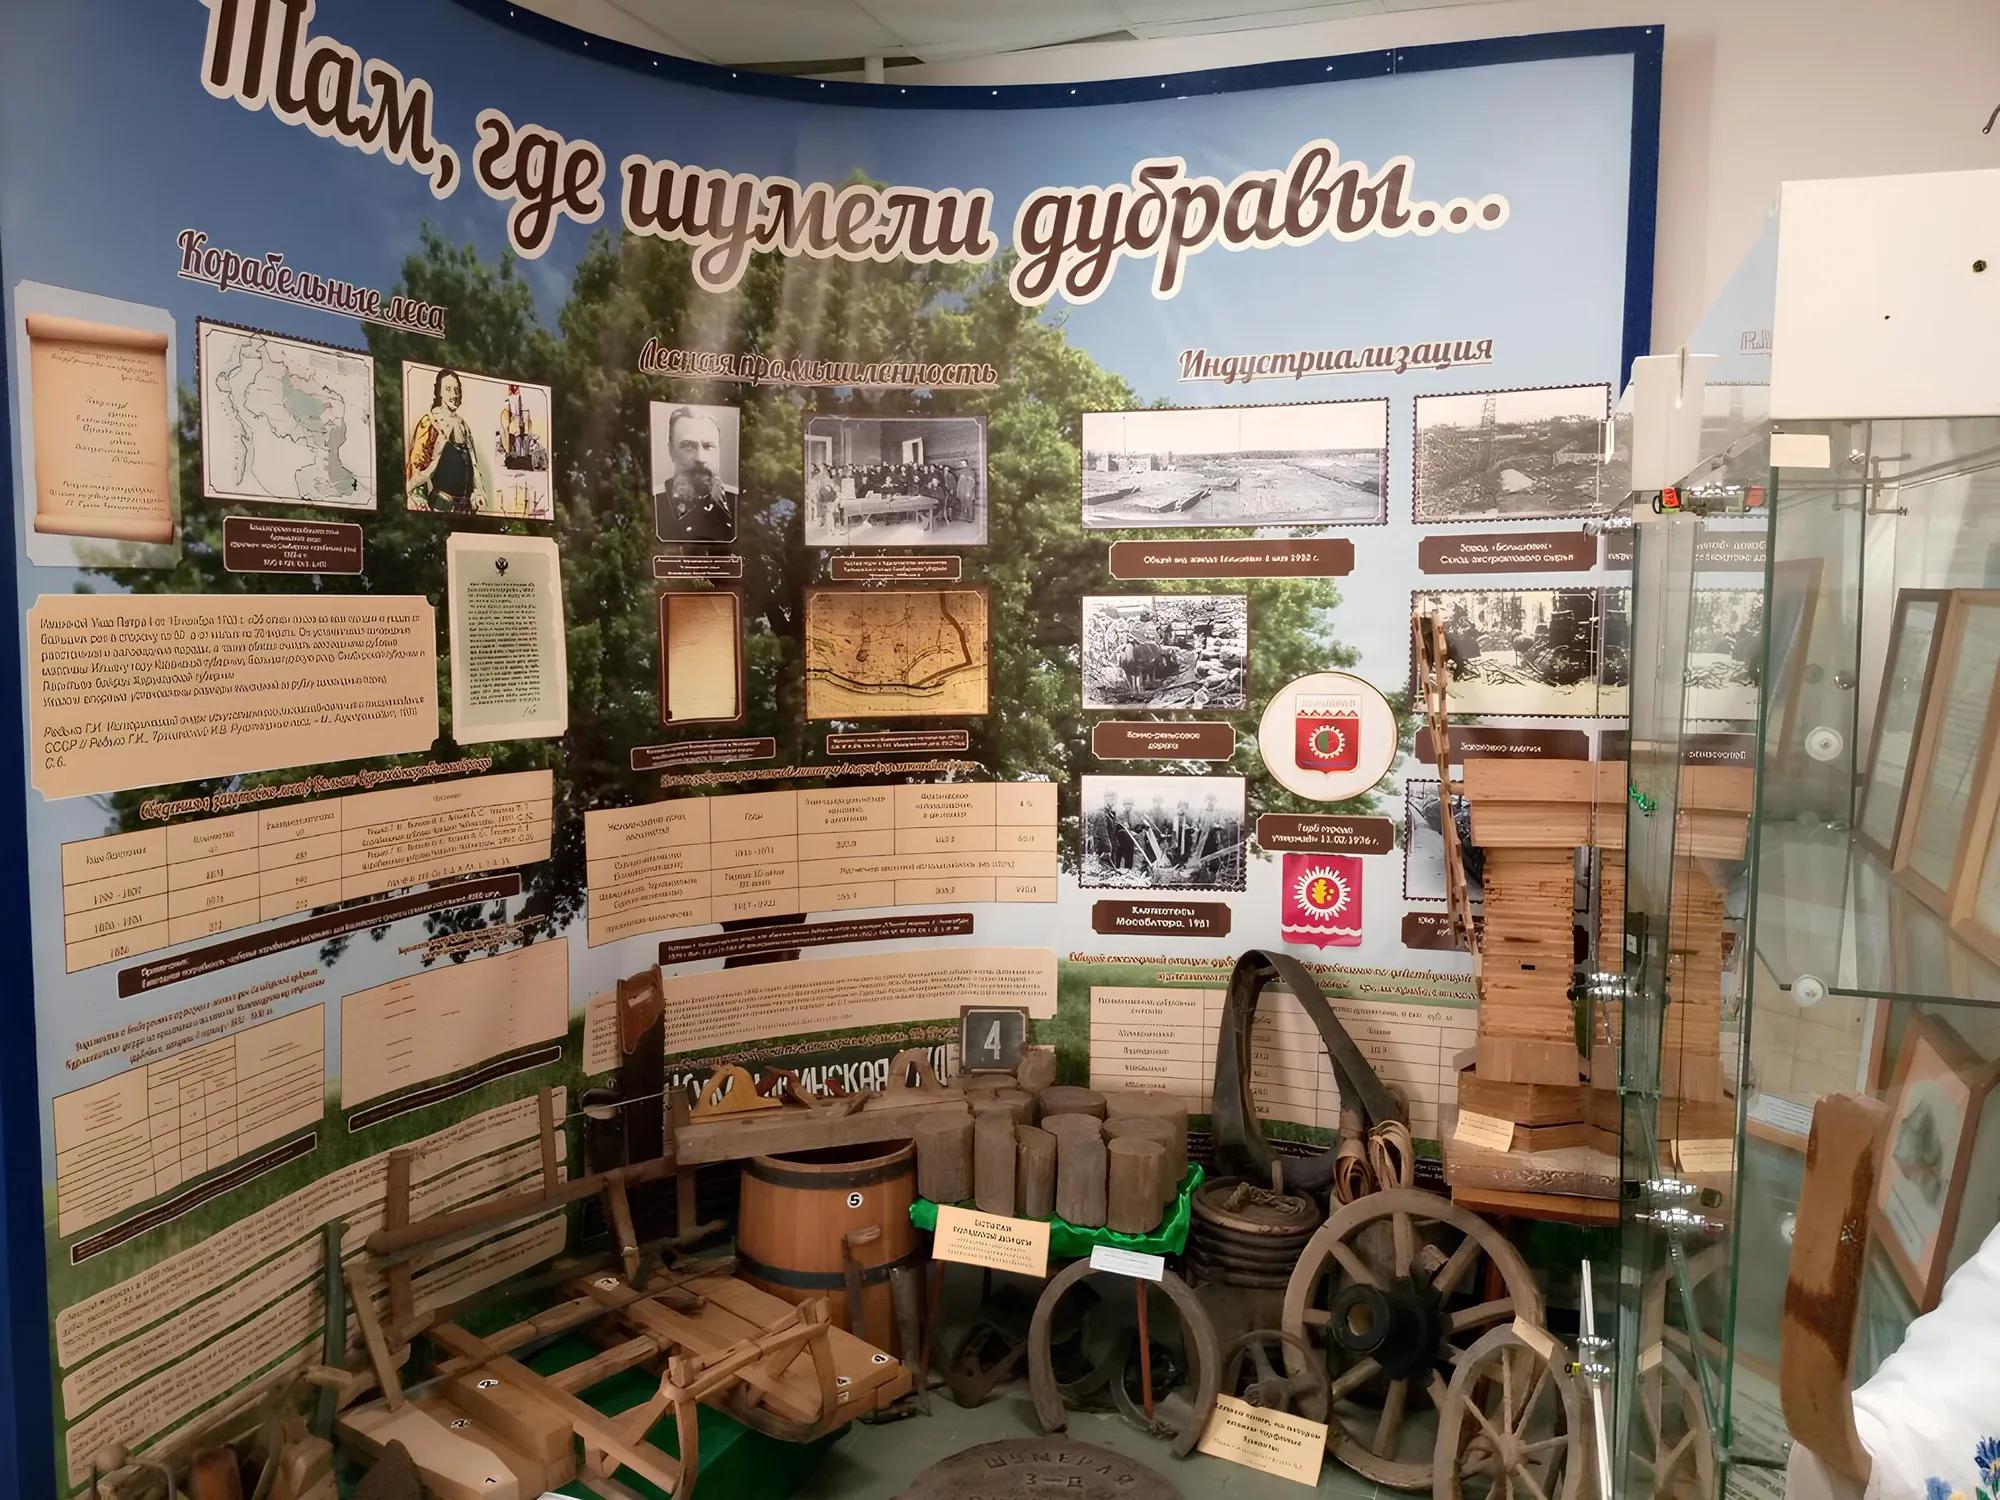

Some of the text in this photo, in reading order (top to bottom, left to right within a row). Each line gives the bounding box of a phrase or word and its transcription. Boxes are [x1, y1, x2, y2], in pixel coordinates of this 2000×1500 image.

[205, 0, 1506, 302] Там, где шумели дубравы...
[178, 229, 446, 332] Корабельные леса
[638, 337, 999, 387] Лесная промышленность
[1179, 338, 1494, 384] Индустриализация
[983, 1020, 1001, 1060] 4
[849, 1192, 861, 1208] 5
